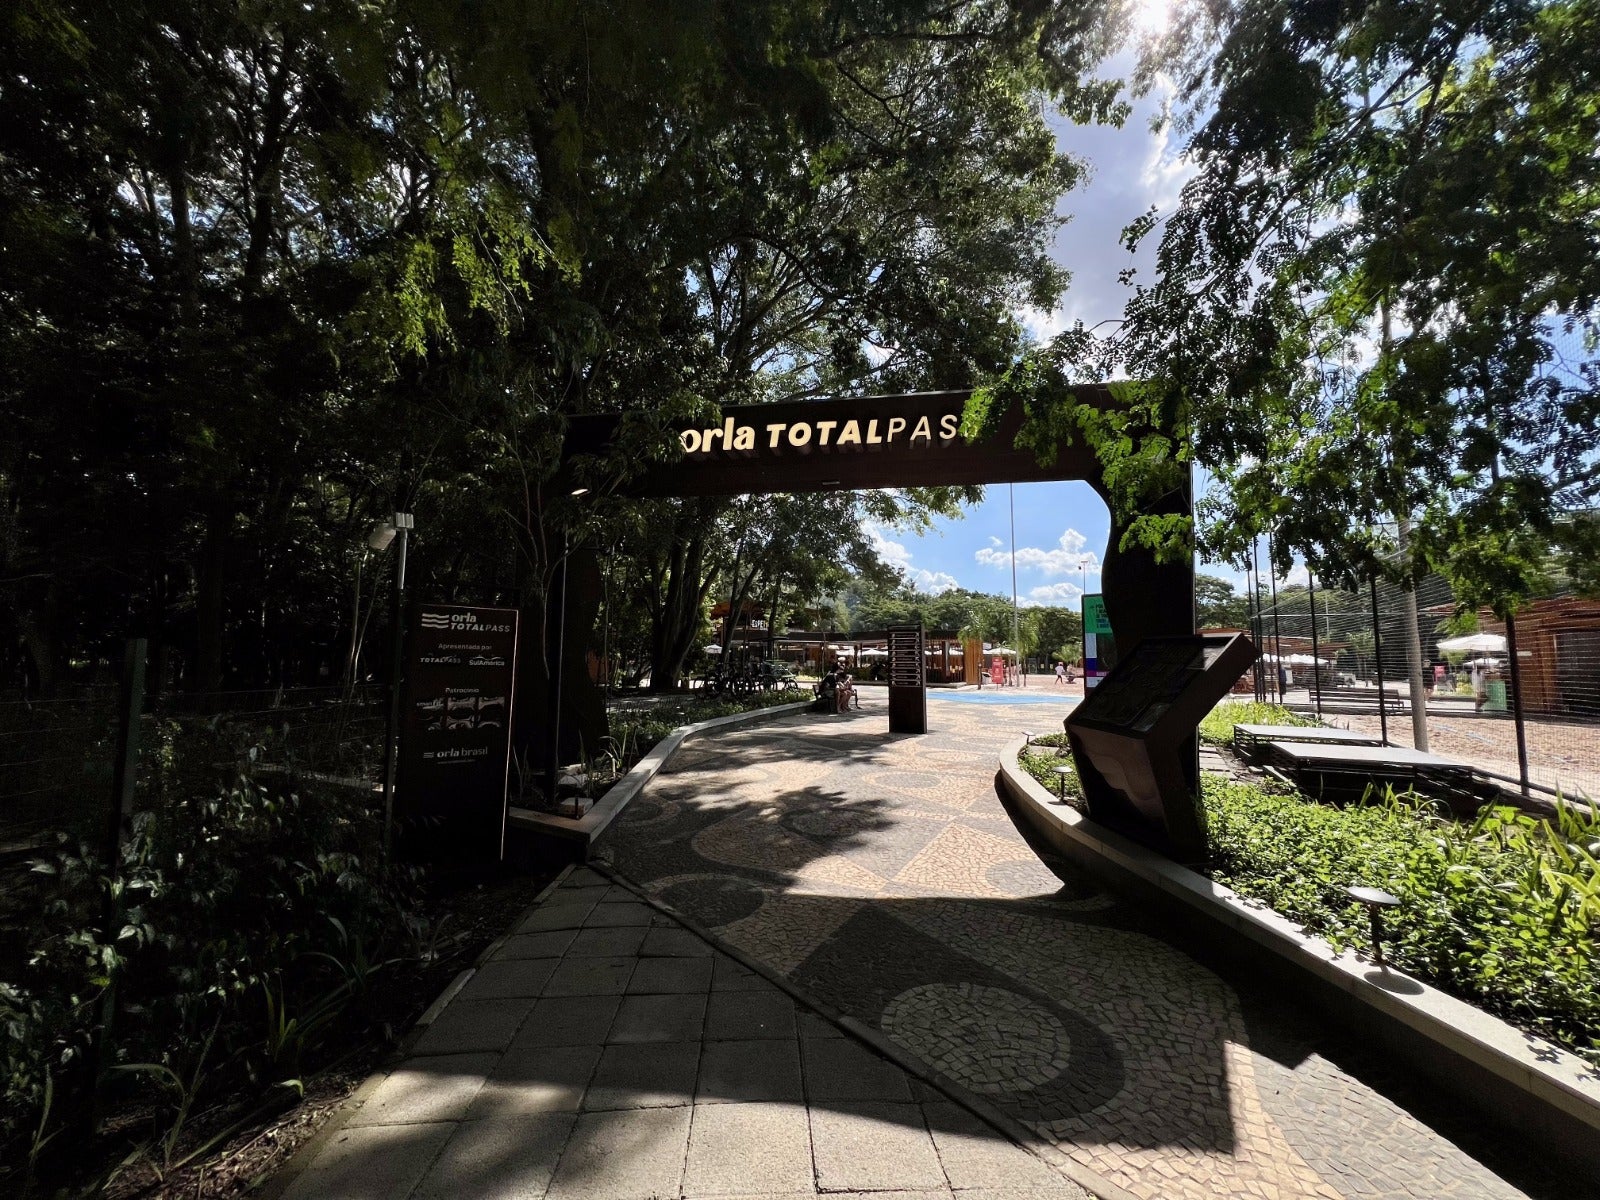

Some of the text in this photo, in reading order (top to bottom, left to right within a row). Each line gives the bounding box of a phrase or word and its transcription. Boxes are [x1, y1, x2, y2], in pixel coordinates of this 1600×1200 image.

[679, 414, 957, 453] orla TOTALPAS
[451, 612, 477, 623] orla
[450, 623, 510, 632] TOTALPASS
[437, 747, 488, 758] orla brasil
